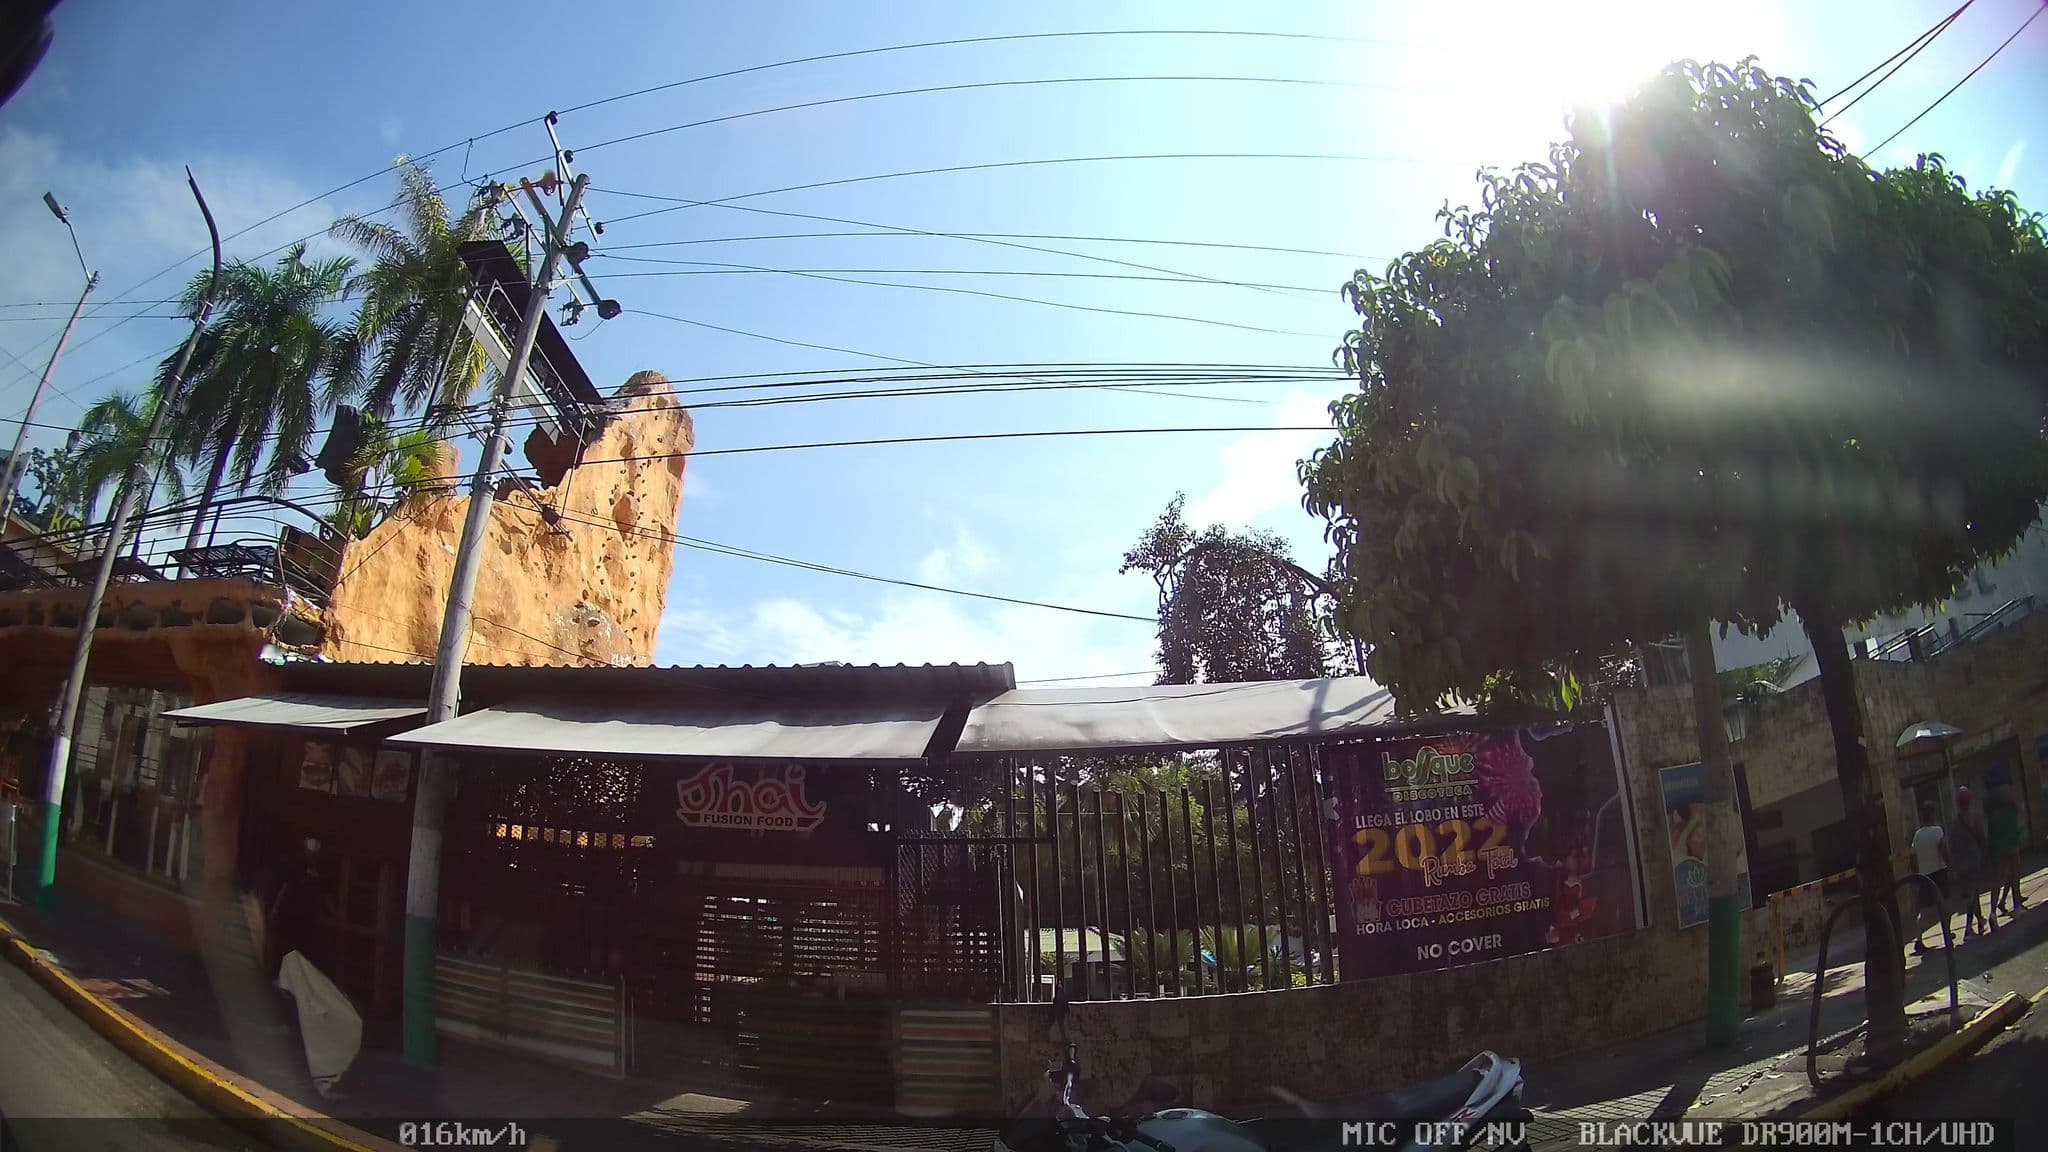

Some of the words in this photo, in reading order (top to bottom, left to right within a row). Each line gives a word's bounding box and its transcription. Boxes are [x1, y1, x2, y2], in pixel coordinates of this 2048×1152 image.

[1392, 785, 1473, 802] DISCOTECA
[703, 813, 752, 826] FUSION
[756, 816, 794, 827] FOOD
[1355, 812, 1393, 829] LLEGA
[1394, 810, 1407, 826] EL
[1409, 807, 1441, 823] LOBO
[1443, 805, 1460, 820] EN
[1461, 803, 1486, 817] ESTE
[1351, 819, 1510, 875] 2022
[1420, 855, 1477, 887] Rumba
[1386, 889, 1473, 918] CUBETAZO
[1475, 881, 1532, 906] GRATIS
[1356, 919, 1393, 936] HORA
[1396, 916, 1429, 931] LOCA
[1438, 903, 1511, 926] ACCESORIOS
[1513, 896, 1550, 914] GRATIS
[1416, 942, 1444, 961] NO
[1447, 932, 1502, 956] COVER
